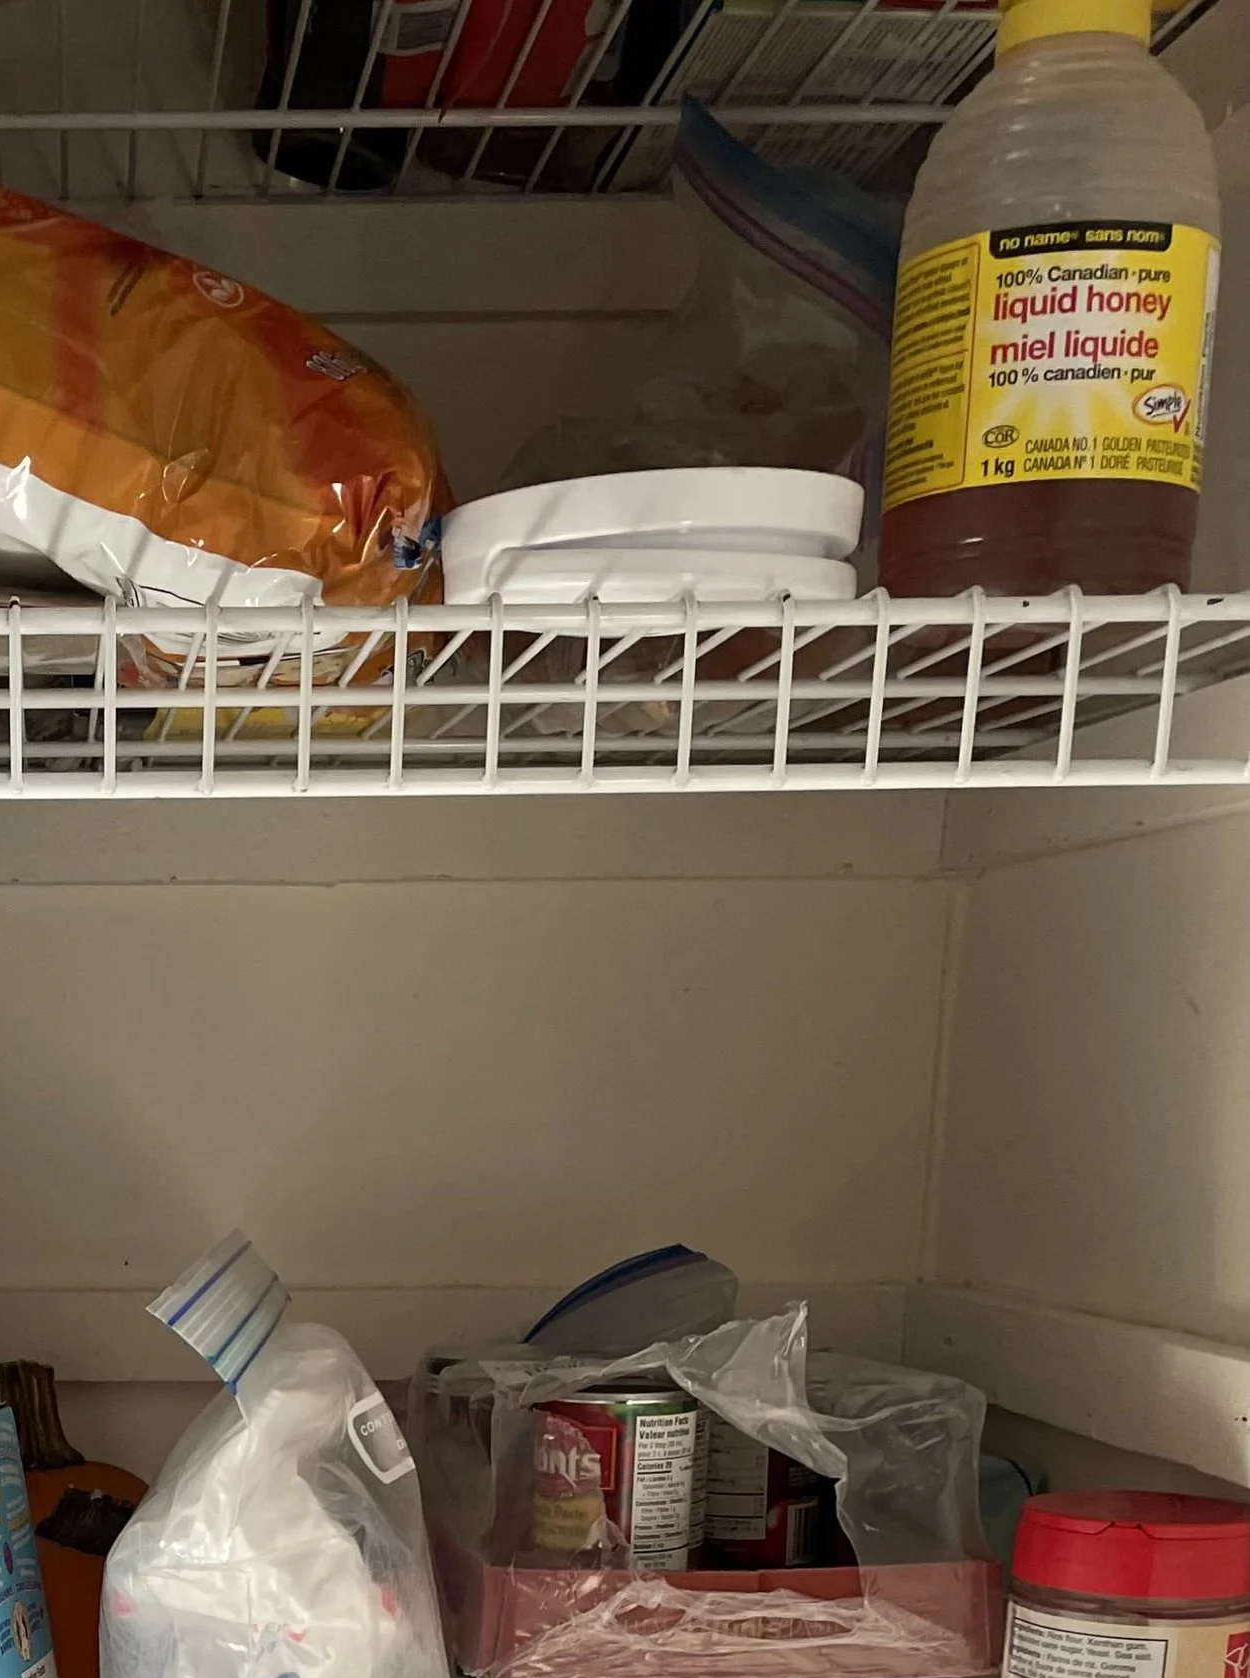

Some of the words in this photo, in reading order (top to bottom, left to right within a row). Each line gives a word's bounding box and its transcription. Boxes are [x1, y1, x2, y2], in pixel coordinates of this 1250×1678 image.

[999, 236, 1020, 251] no
[1024, 231, 1071, 248] name
[1085, 229, 1124, 244] sans
[1127, 229, 1159, 244] nom
[996, 267, 1043, 289] 100%
[1047, 263, 1129, 283] Canadian
[1137, 267, 1171, 286] pure
[993, 285, 1078, 324] liquid
[1086, 285, 1172, 321] honey
[990, 332, 1056, 366] miel
[1064, 329, 1160, 363] liquide
[988, 371, 1018, 388] 100
[1043, 364, 1120, 383] canadien
[1130, 366, 1156, 385] pur
[1025, 439, 1070, 455] CANADA
[1092, 436, 1098, 451] 1
[1102, 436, 1143, 452] GOLDEN
[981, 459, 989, 477] 1
[993, 457, 1016, 478] kg
[1023, 455, 1072, 473] CANADA
[1090, 455, 1095, 470] 1
[1100, 454, 1130, 470] DORÉ
[639, 1416, 673, 1429] Nutrition
[639, 1429, 665, 1440] Valeur
